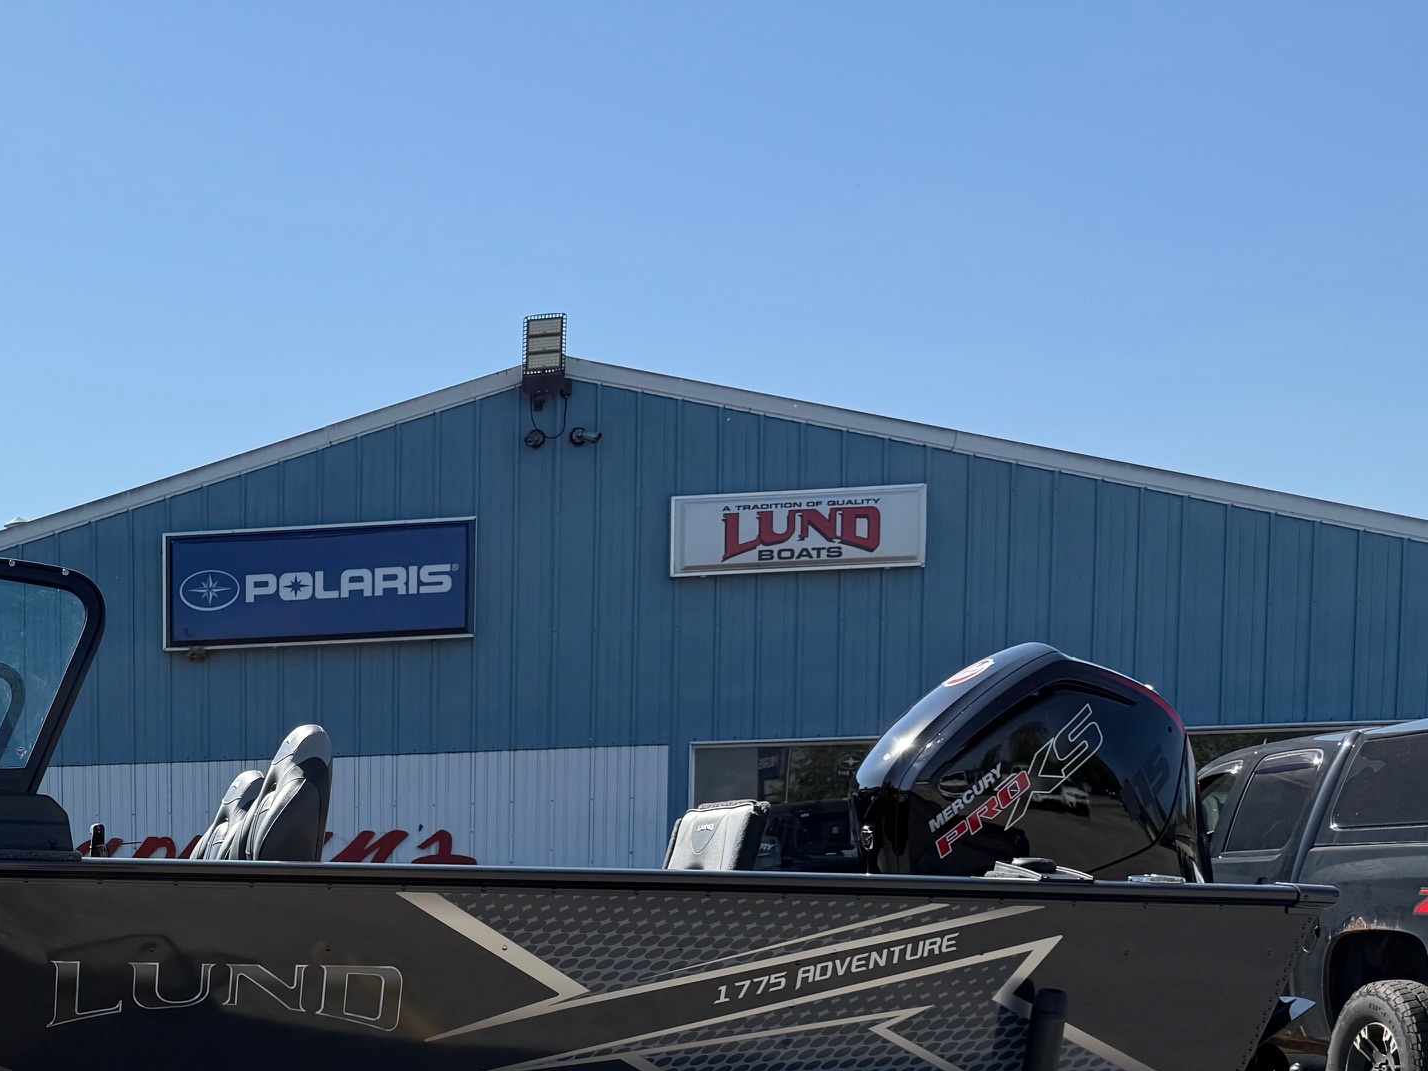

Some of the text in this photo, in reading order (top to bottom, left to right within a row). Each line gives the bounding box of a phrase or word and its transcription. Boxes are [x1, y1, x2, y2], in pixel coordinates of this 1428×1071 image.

[721, 506, 881, 562] LUND
[735, 502, 802, 512] TRADITION
[806, 500, 823, 508] OF
[827, 498, 881, 507] QUALITY
[758, 546, 843, 561] BOATS
[928, 762, 1003, 833] MERCURY
[935, 770, 1031, 860] PRO
[46, 960, 404, 1033] LUND
[713, 932, 961, 1005] 1775 ADVENTURE
